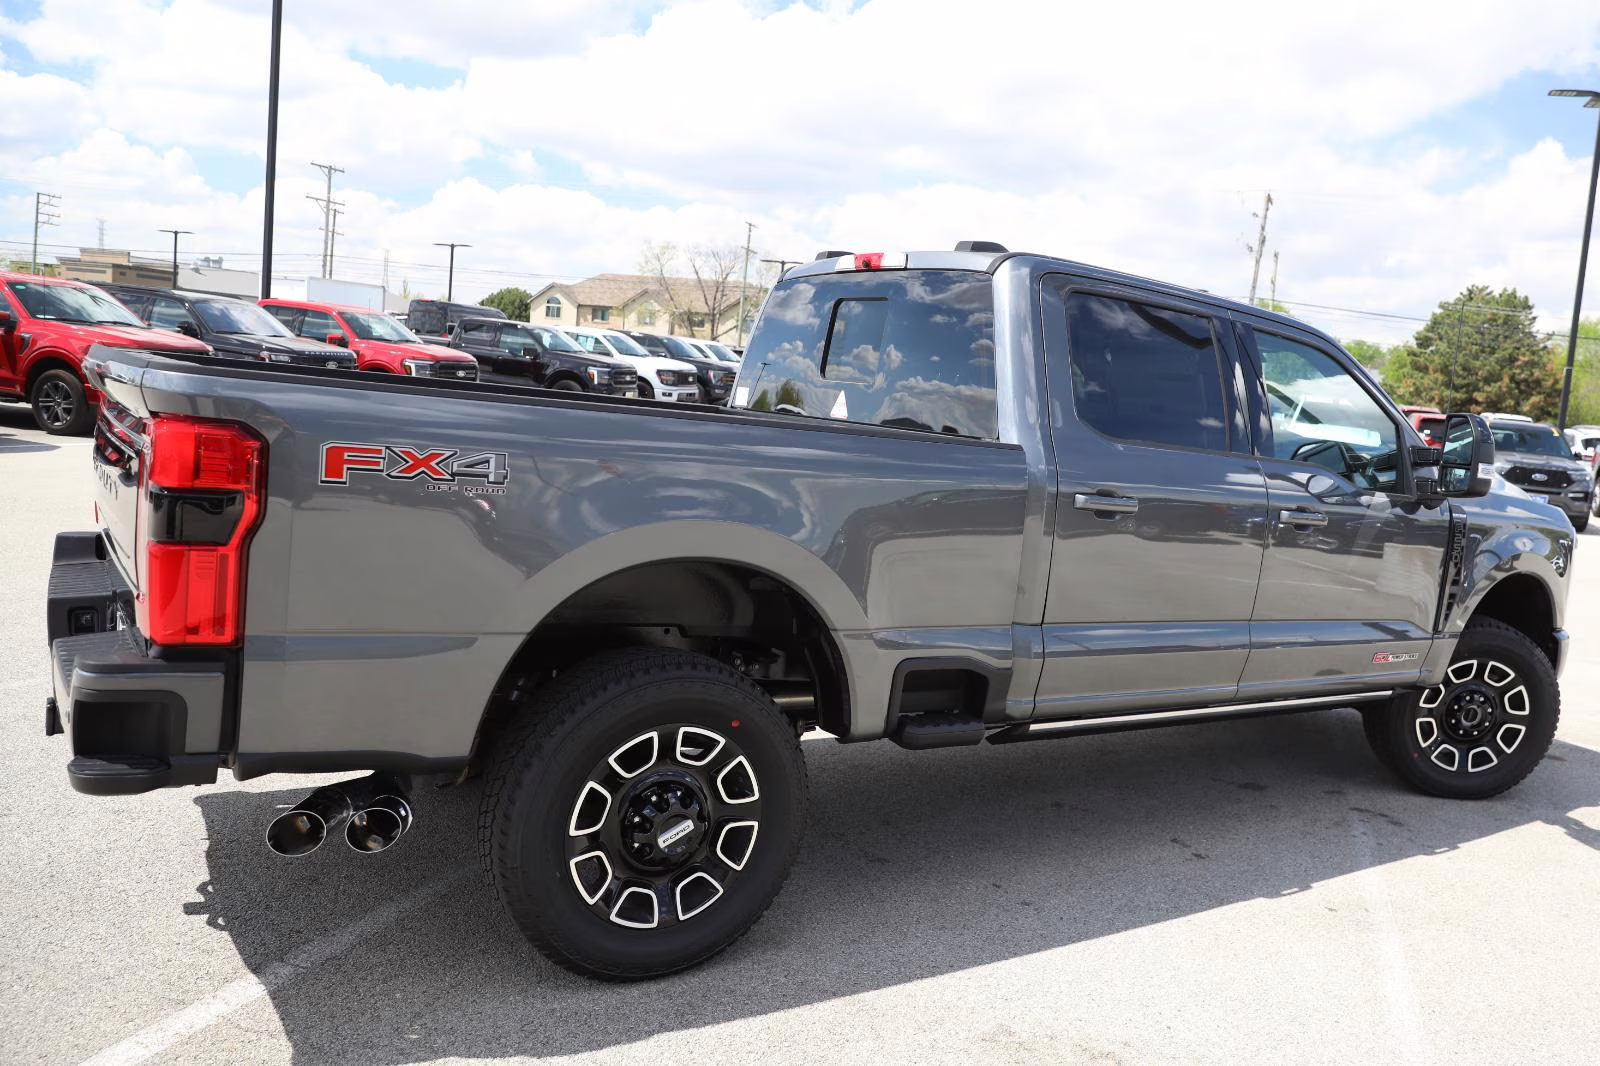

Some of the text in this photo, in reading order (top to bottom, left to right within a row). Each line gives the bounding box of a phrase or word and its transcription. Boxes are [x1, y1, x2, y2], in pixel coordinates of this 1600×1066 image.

[319, 441, 509, 486] FX4
[426, 484, 506, 495] OFF ROAD
[662, 824, 690, 844] FORD
